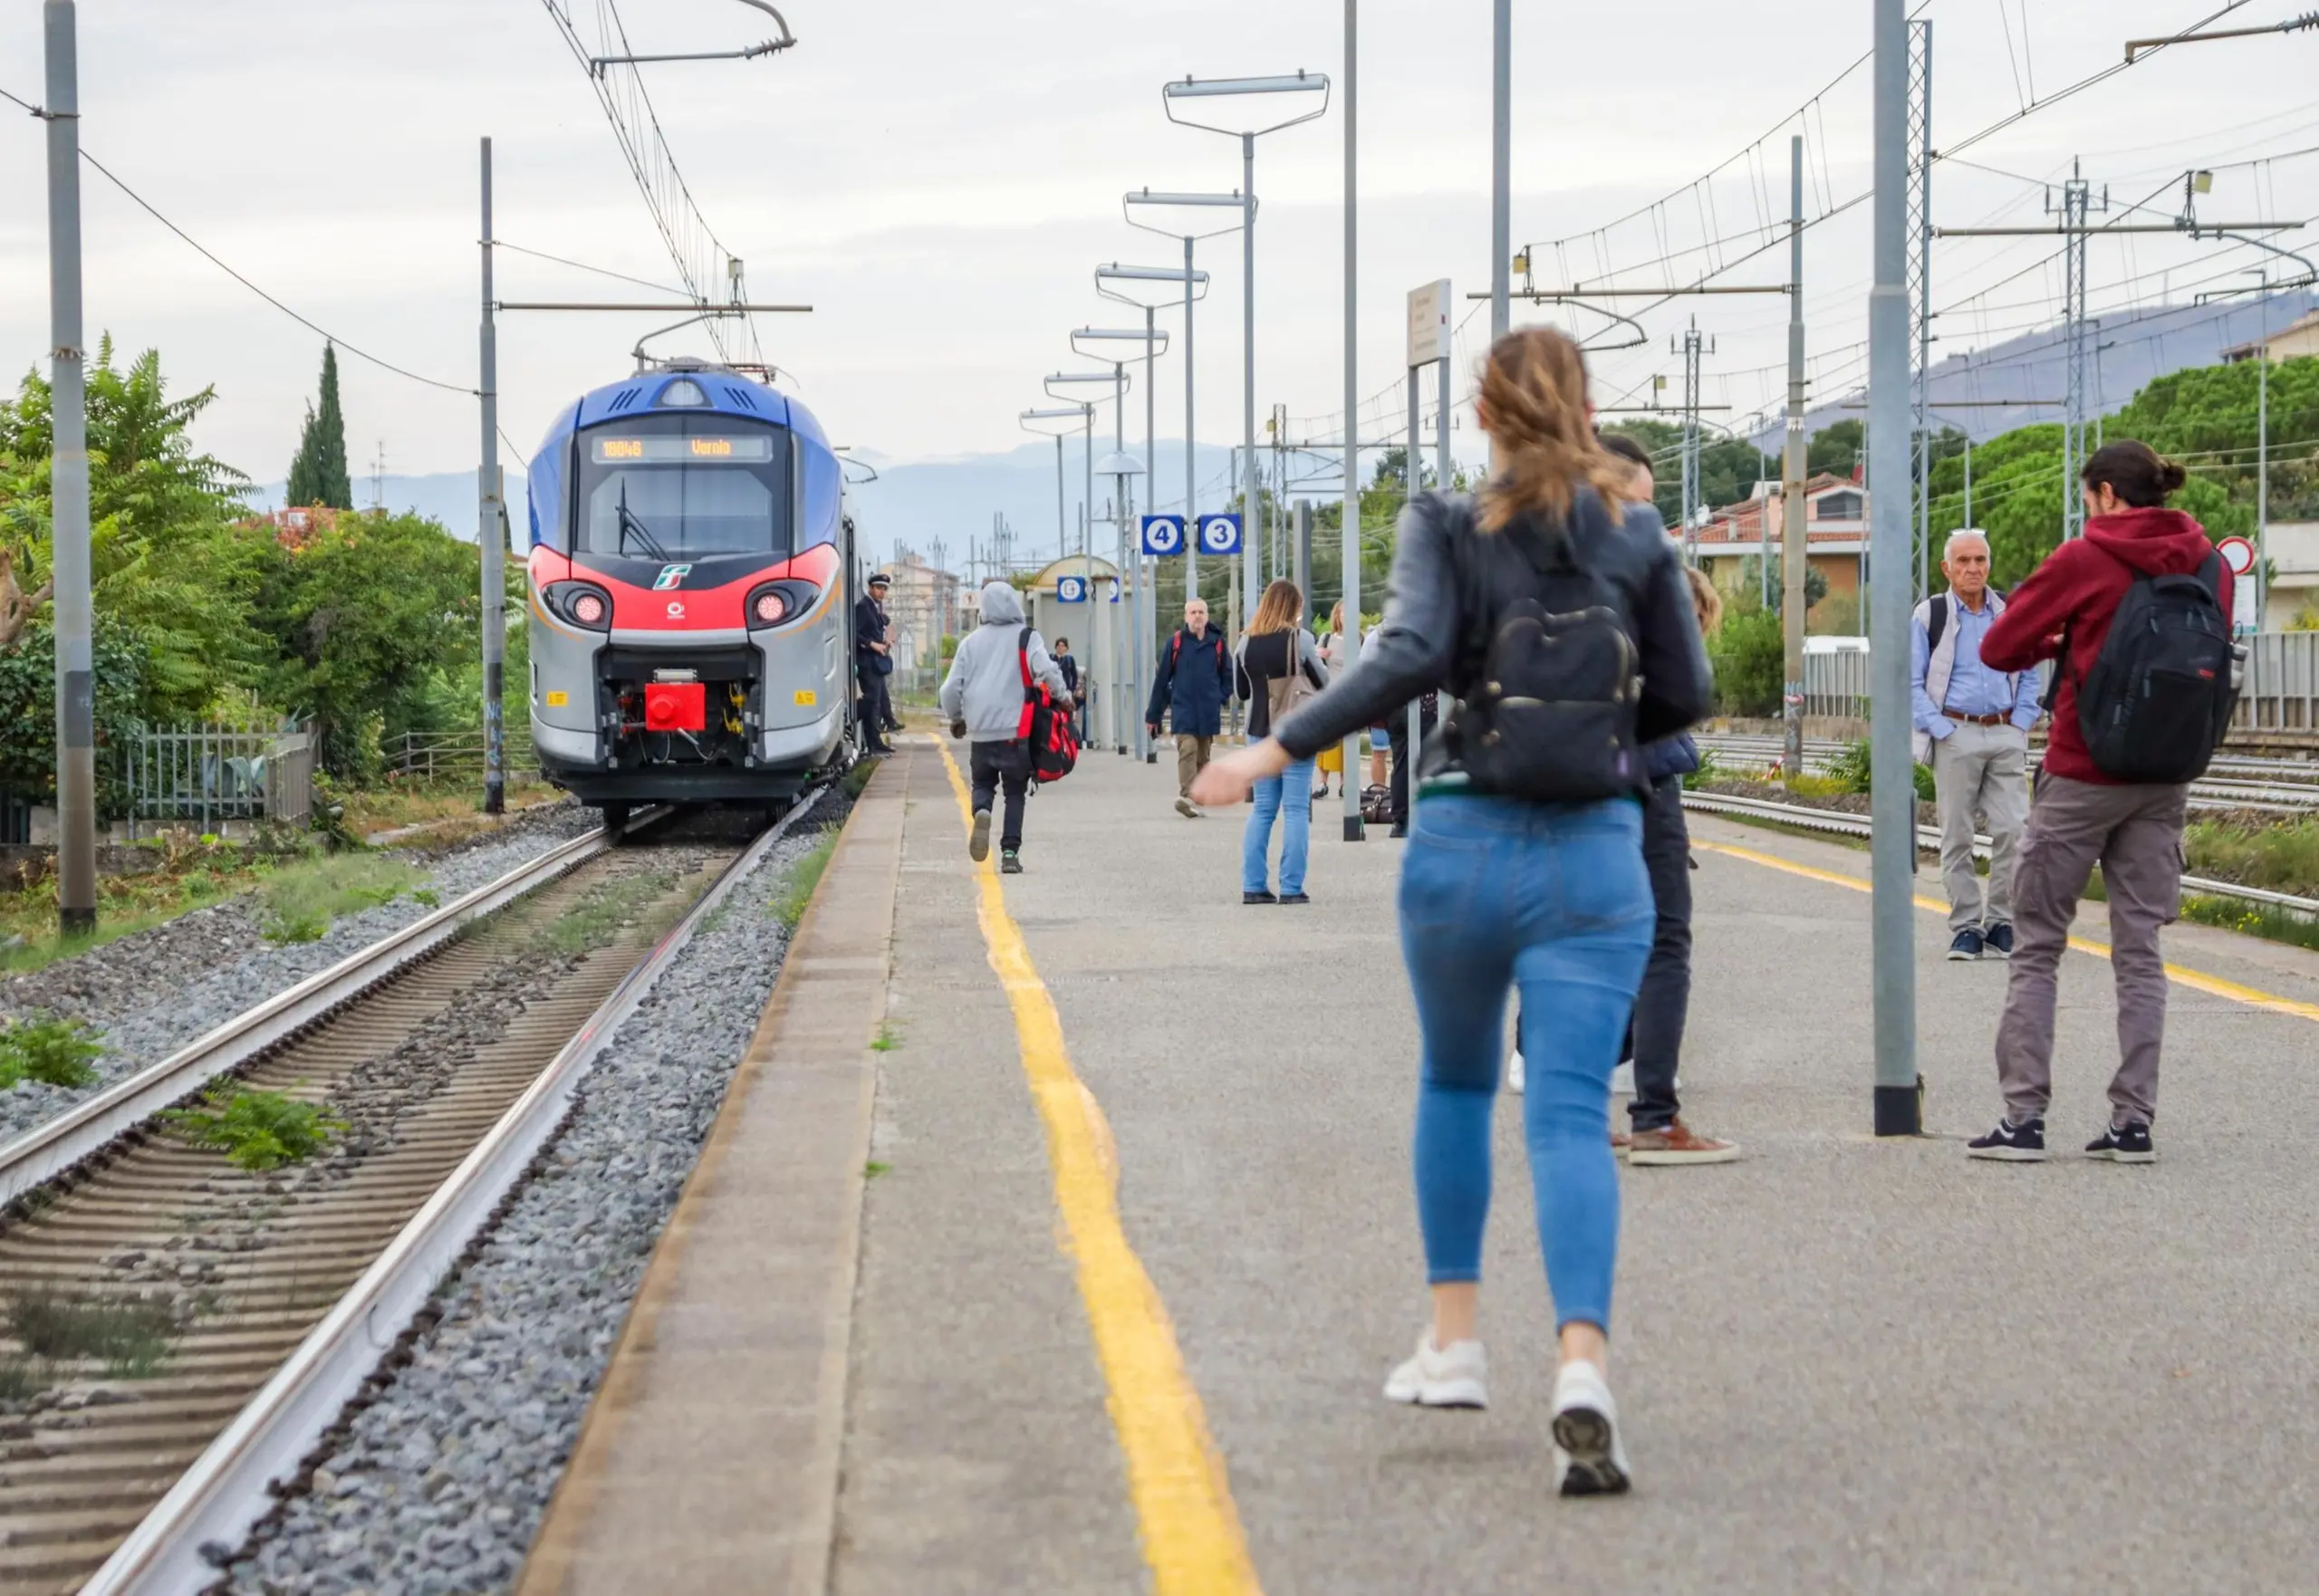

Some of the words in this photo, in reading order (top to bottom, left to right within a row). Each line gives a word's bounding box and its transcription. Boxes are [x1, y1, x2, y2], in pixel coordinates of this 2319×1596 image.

[691, 438, 732, 456] Vernio
[1154, 524, 1170, 544] 4
[1213, 524, 1229, 543] 3
